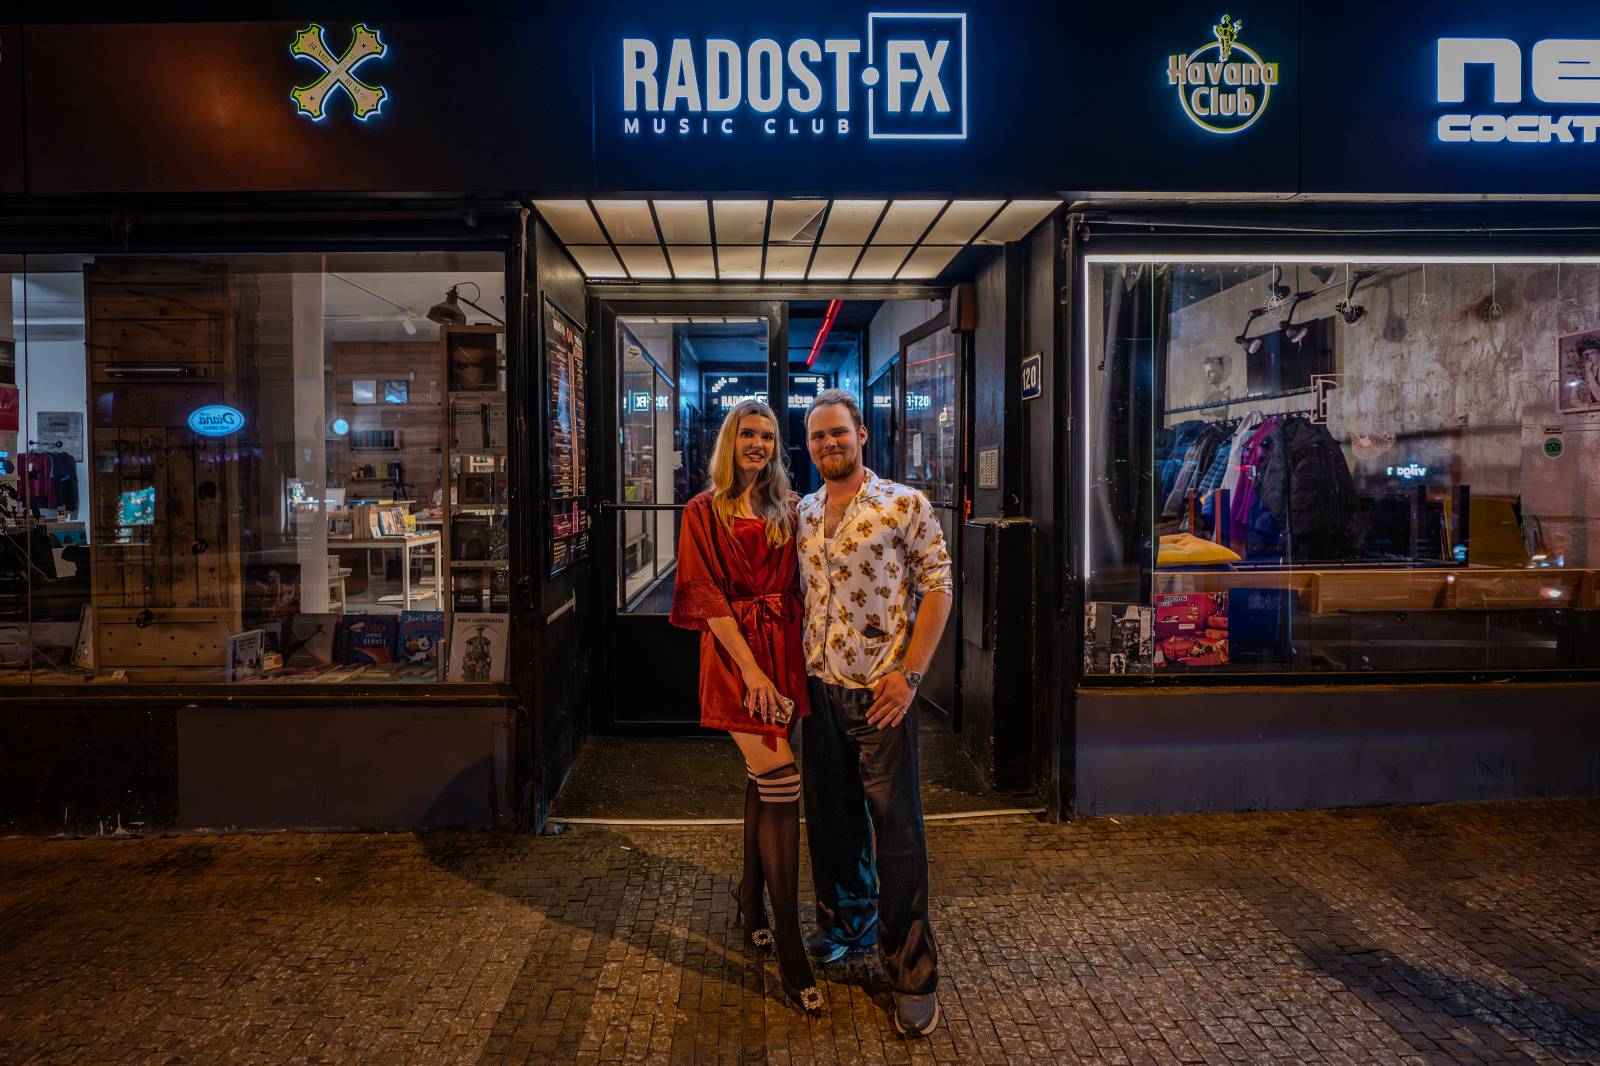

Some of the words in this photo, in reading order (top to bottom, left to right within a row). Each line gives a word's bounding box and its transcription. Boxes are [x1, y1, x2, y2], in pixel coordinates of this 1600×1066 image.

[623, 38, 861, 112] RADOST
[887, 40, 951, 112] FX
[1167, 54, 1278, 85] Havana
[1191, 86, 1255, 115] Club
[624, 118, 734, 134] MUSIC
[764, 118, 850, 134] CLUB
[1022, 364, 1037, 391] 120
